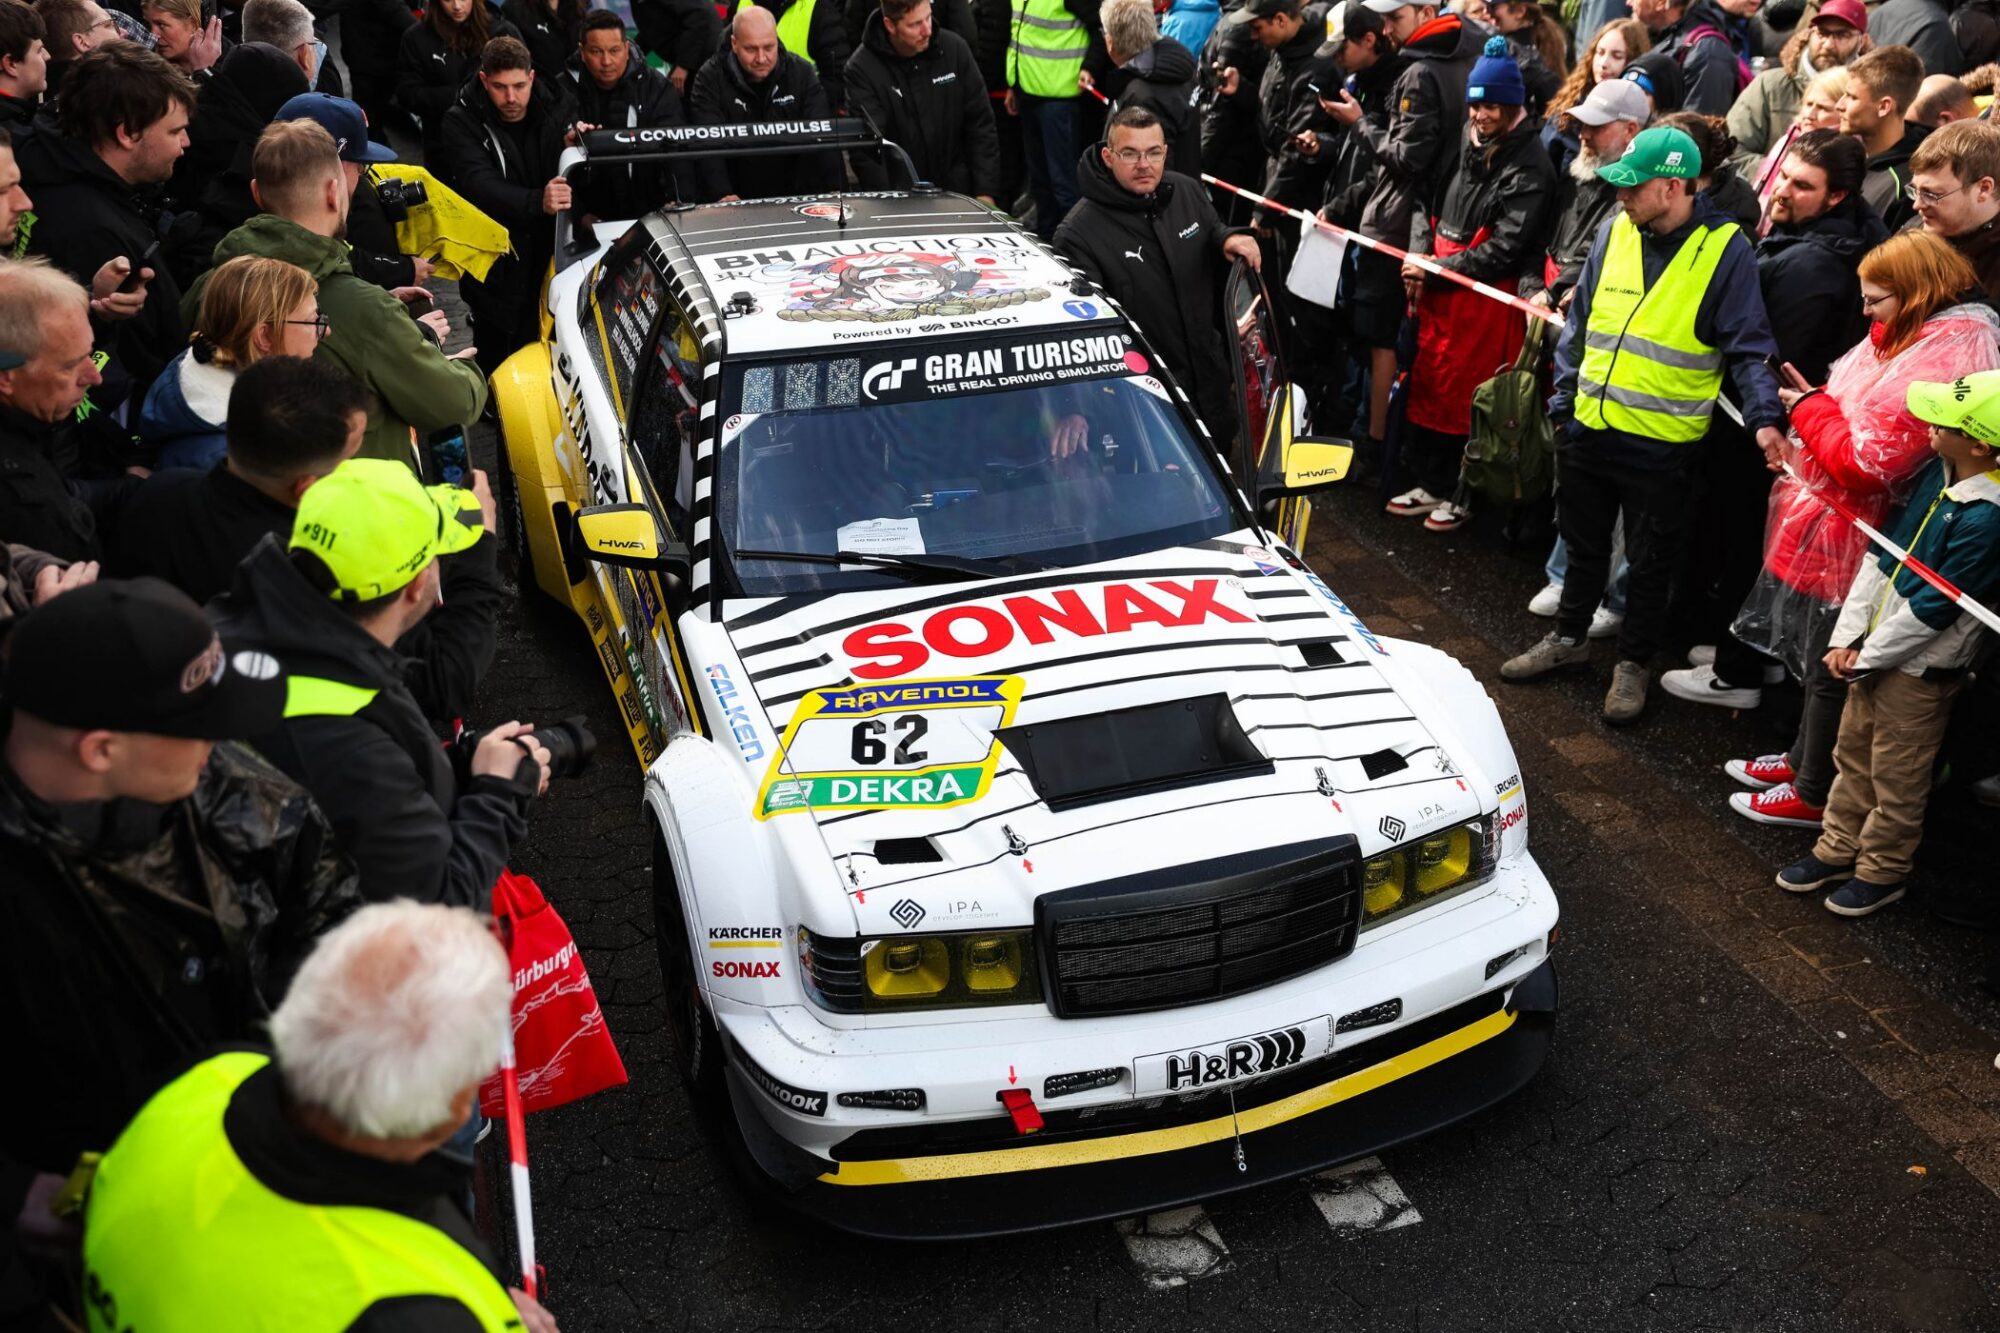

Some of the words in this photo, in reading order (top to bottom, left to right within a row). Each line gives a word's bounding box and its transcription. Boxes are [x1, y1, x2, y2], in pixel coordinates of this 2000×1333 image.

[640, 124, 749, 142] COMPOSITE
[753, 119, 832, 136] IMPULSE
[1178, 221, 1200, 239] HWA
[714, 250, 796, 271] BH
[803, 235, 1021, 262] AUCTION
[832, 328, 893, 340] Powered
[898, 325, 912, 338] by
[925, 348, 1001, 382] GRAN
[1010, 334, 1126, 369] TURISMO
[927, 383, 958, 394] THE
[960, 379, 996, 392] REAL
[1000, 371, 1055, 387] DRIVING
[1058, 361, 1128, 380] SIMULATOR
[1297, 468, 1338, 480] HWA
[303, 523, 337, 550] #911
[598, 539, 646, 551] HWA
[842, 578, 1258, 680] SONAX
[834, 684, 991, 709] RAVENOL
[705, 663, 765, 763] FALKEN
[850, 713, 928, 766] 62
[830, 772, 965, 804] DEKRA
[1418, 804, 1445, 820] IPA
[948, 900, 983, 914] IPA
[708, 926, 783, 939] KÄRCHER
[711, 960, 782, 978] SONAX
[1166, 1038, 1260, 1091] H&R
